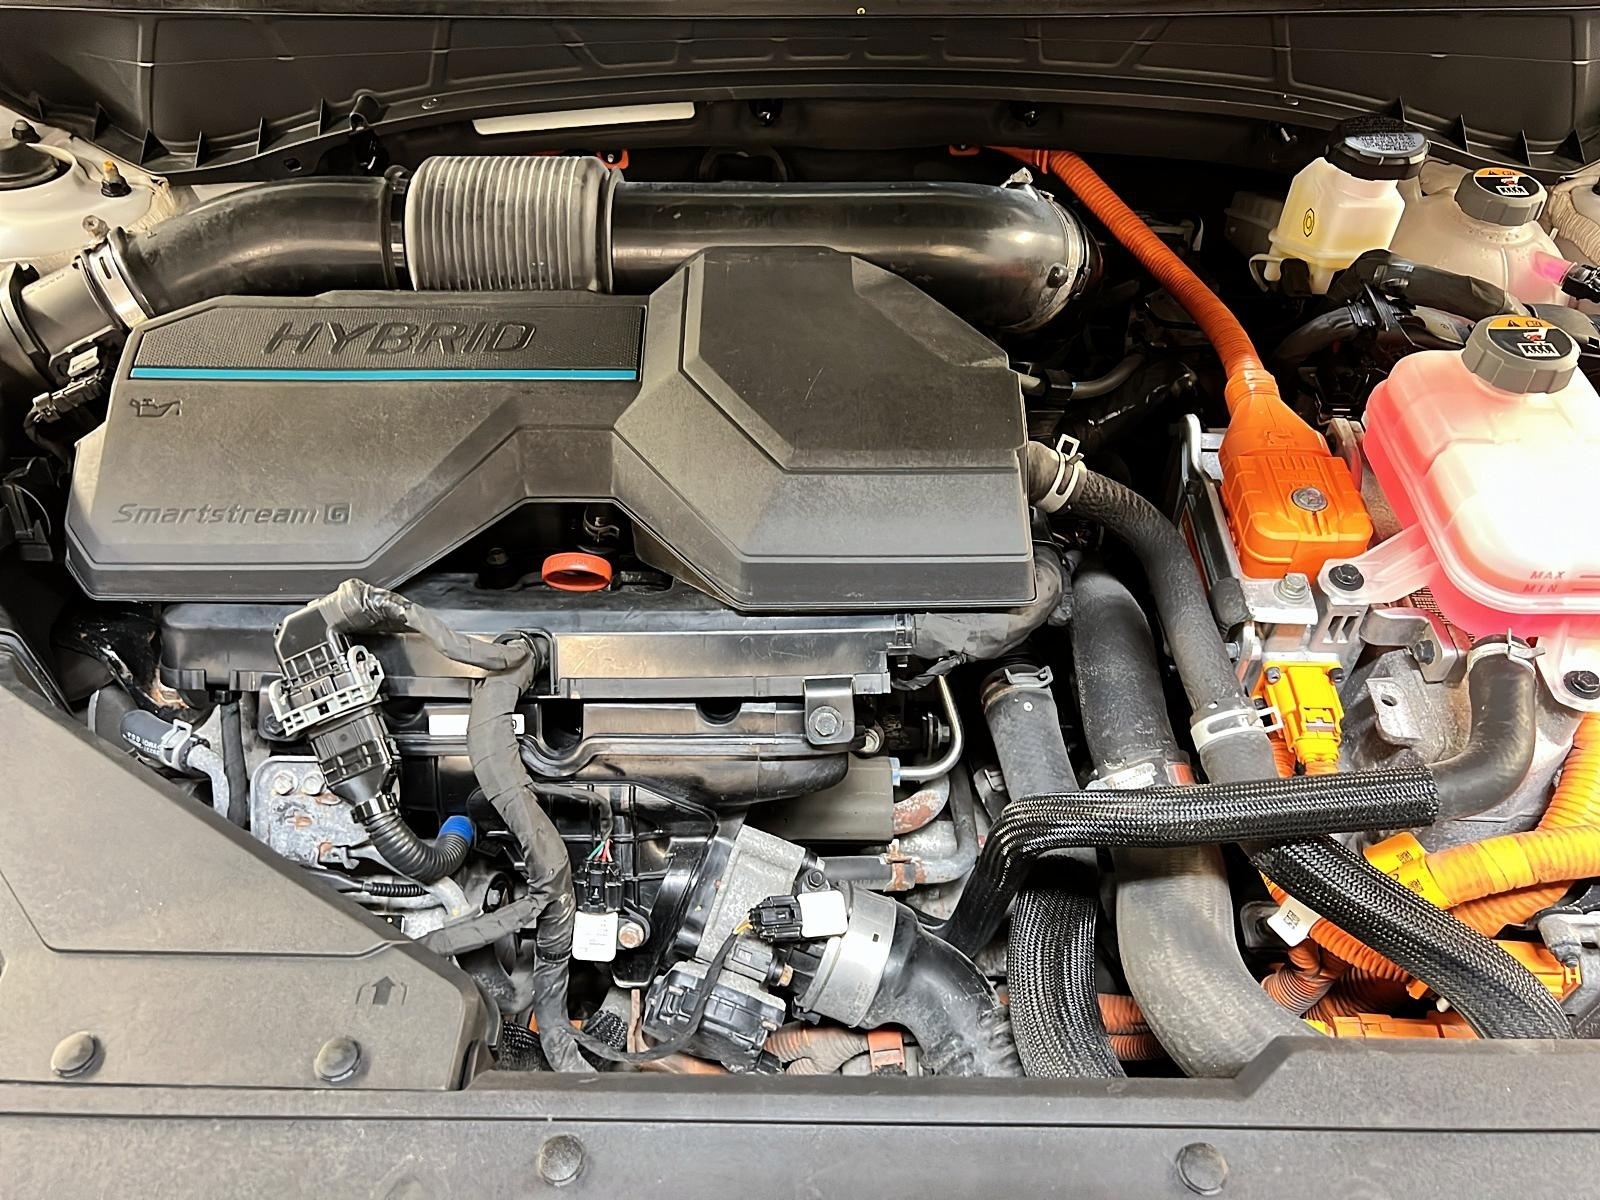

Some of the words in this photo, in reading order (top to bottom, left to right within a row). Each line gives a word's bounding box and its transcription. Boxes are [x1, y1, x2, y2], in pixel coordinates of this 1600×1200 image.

[261, 321, 536, 354] HYBRID
[113, 503, 319, 524] Smartstream
[324, 502, 352, 525] G
[1529, 570, 1565, 580] MAX
[1522, 583, 1558, 593] MIN
